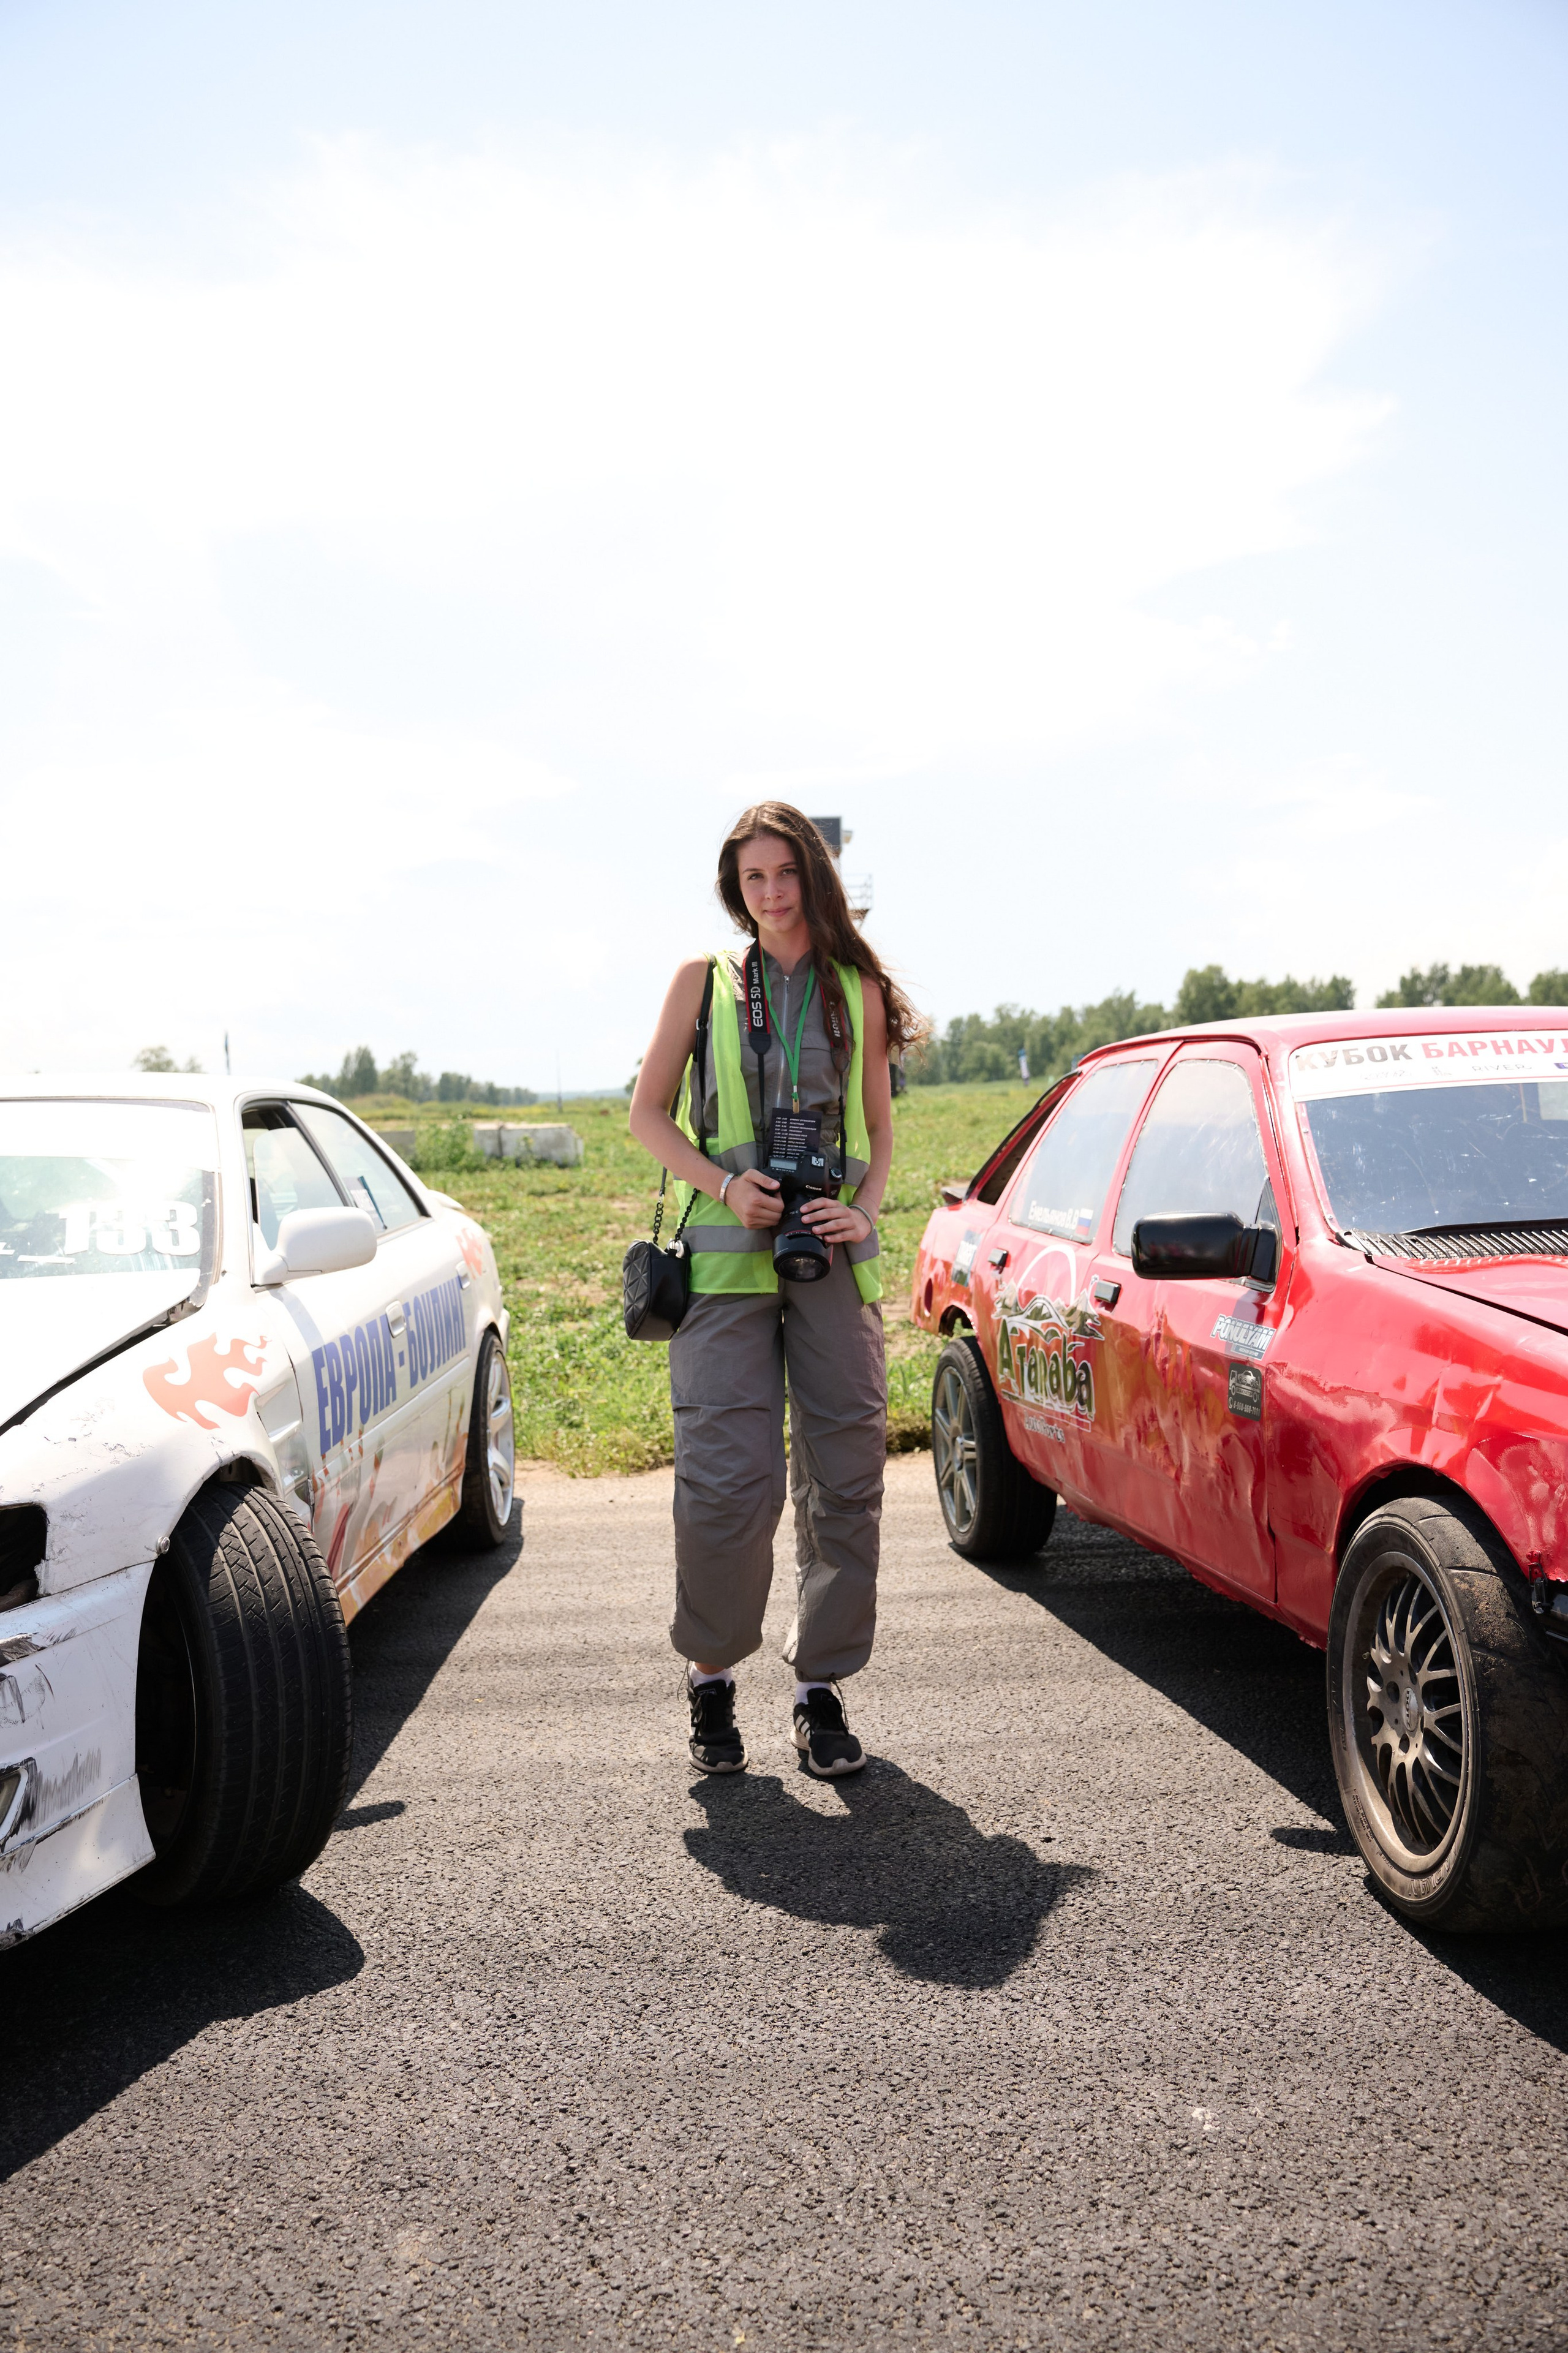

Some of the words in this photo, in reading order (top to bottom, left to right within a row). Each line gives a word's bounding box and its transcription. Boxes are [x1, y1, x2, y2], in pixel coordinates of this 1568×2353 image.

[750, 986, 761, 999] 5D
[752, 1002, 763, 1027] EOS
[1295, 1044, 1412, 1071] КУБОК
